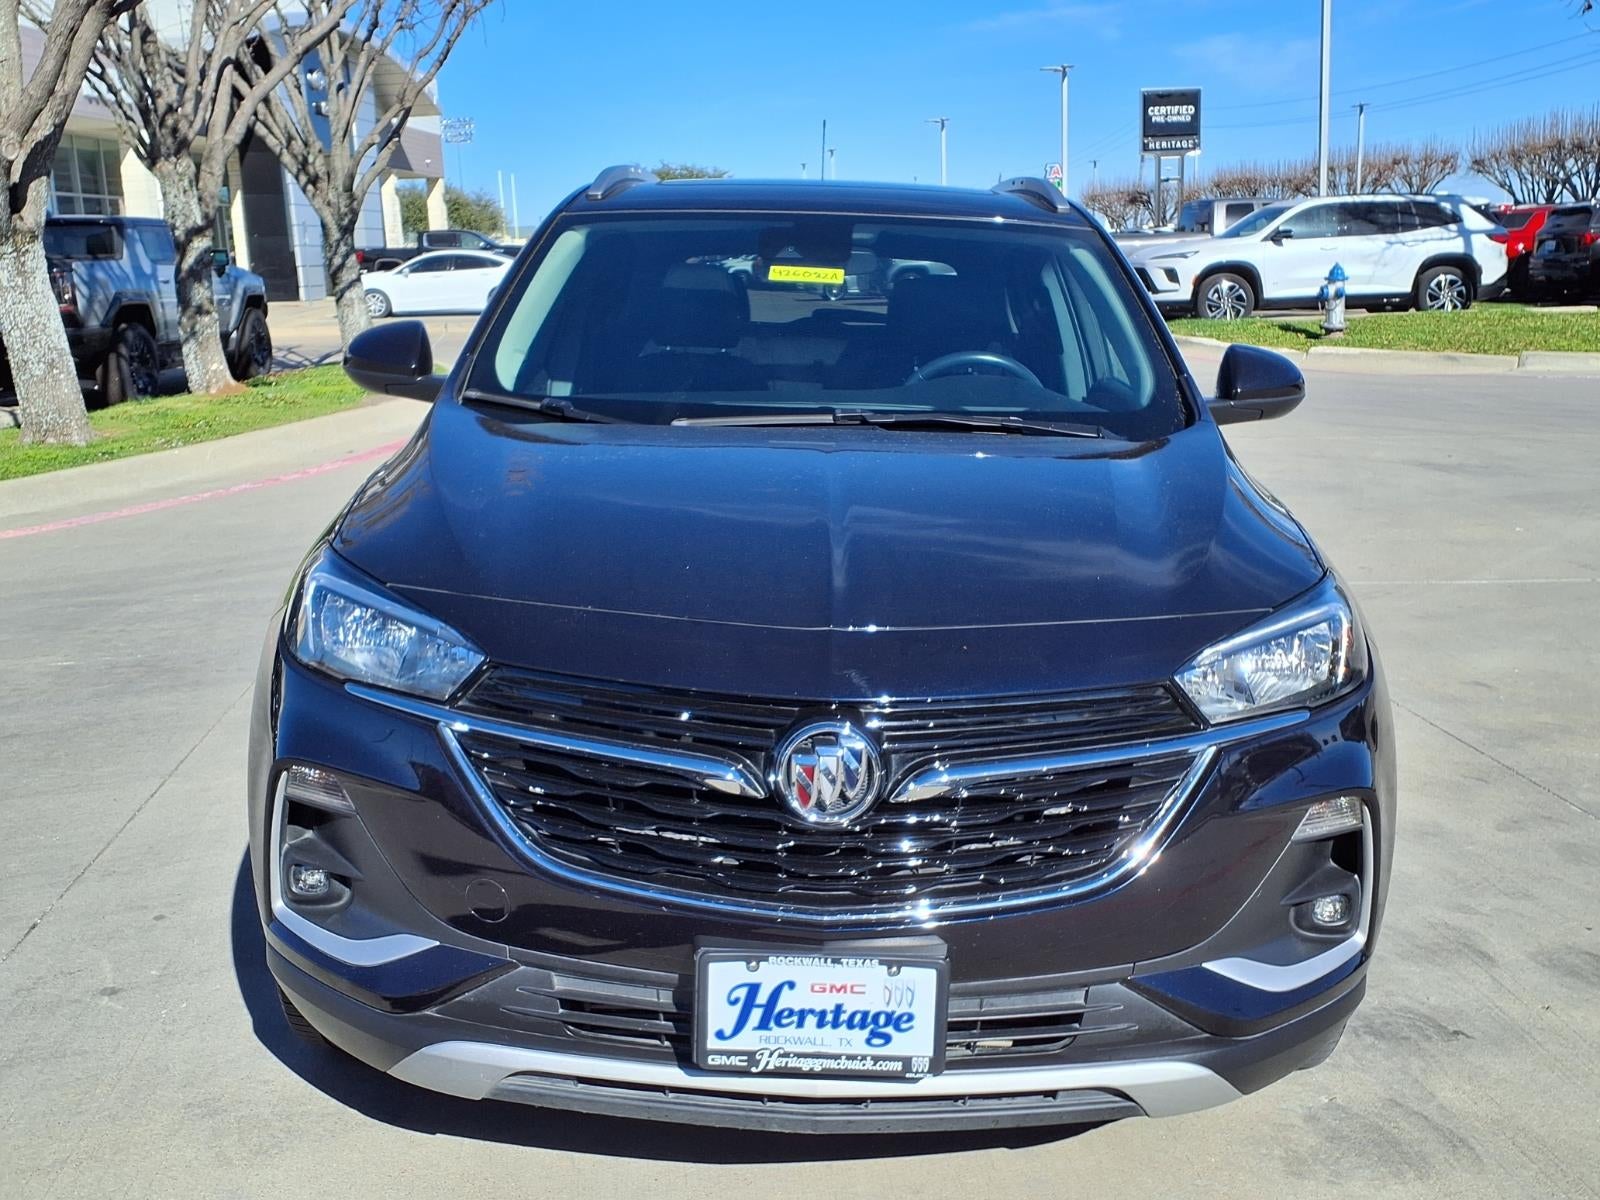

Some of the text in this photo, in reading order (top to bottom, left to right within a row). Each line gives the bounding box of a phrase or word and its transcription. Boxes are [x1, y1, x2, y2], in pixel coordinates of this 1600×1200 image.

[1148, 104, 1195, 116] CERTIFIED
[1152, 115, 1191, 123] PRE-OWNED
[1149, 140, 1195, 150] HERITAGE
[840, 958, 880, 968] TEXAS
[810, 982, 867, 995] GMC
[714, 979, 915, 1048] Heritage
[838, 1037, 853, 1048] TX
[707, 1048, 903, 1073] GMC Heritagegmcbuick.com
